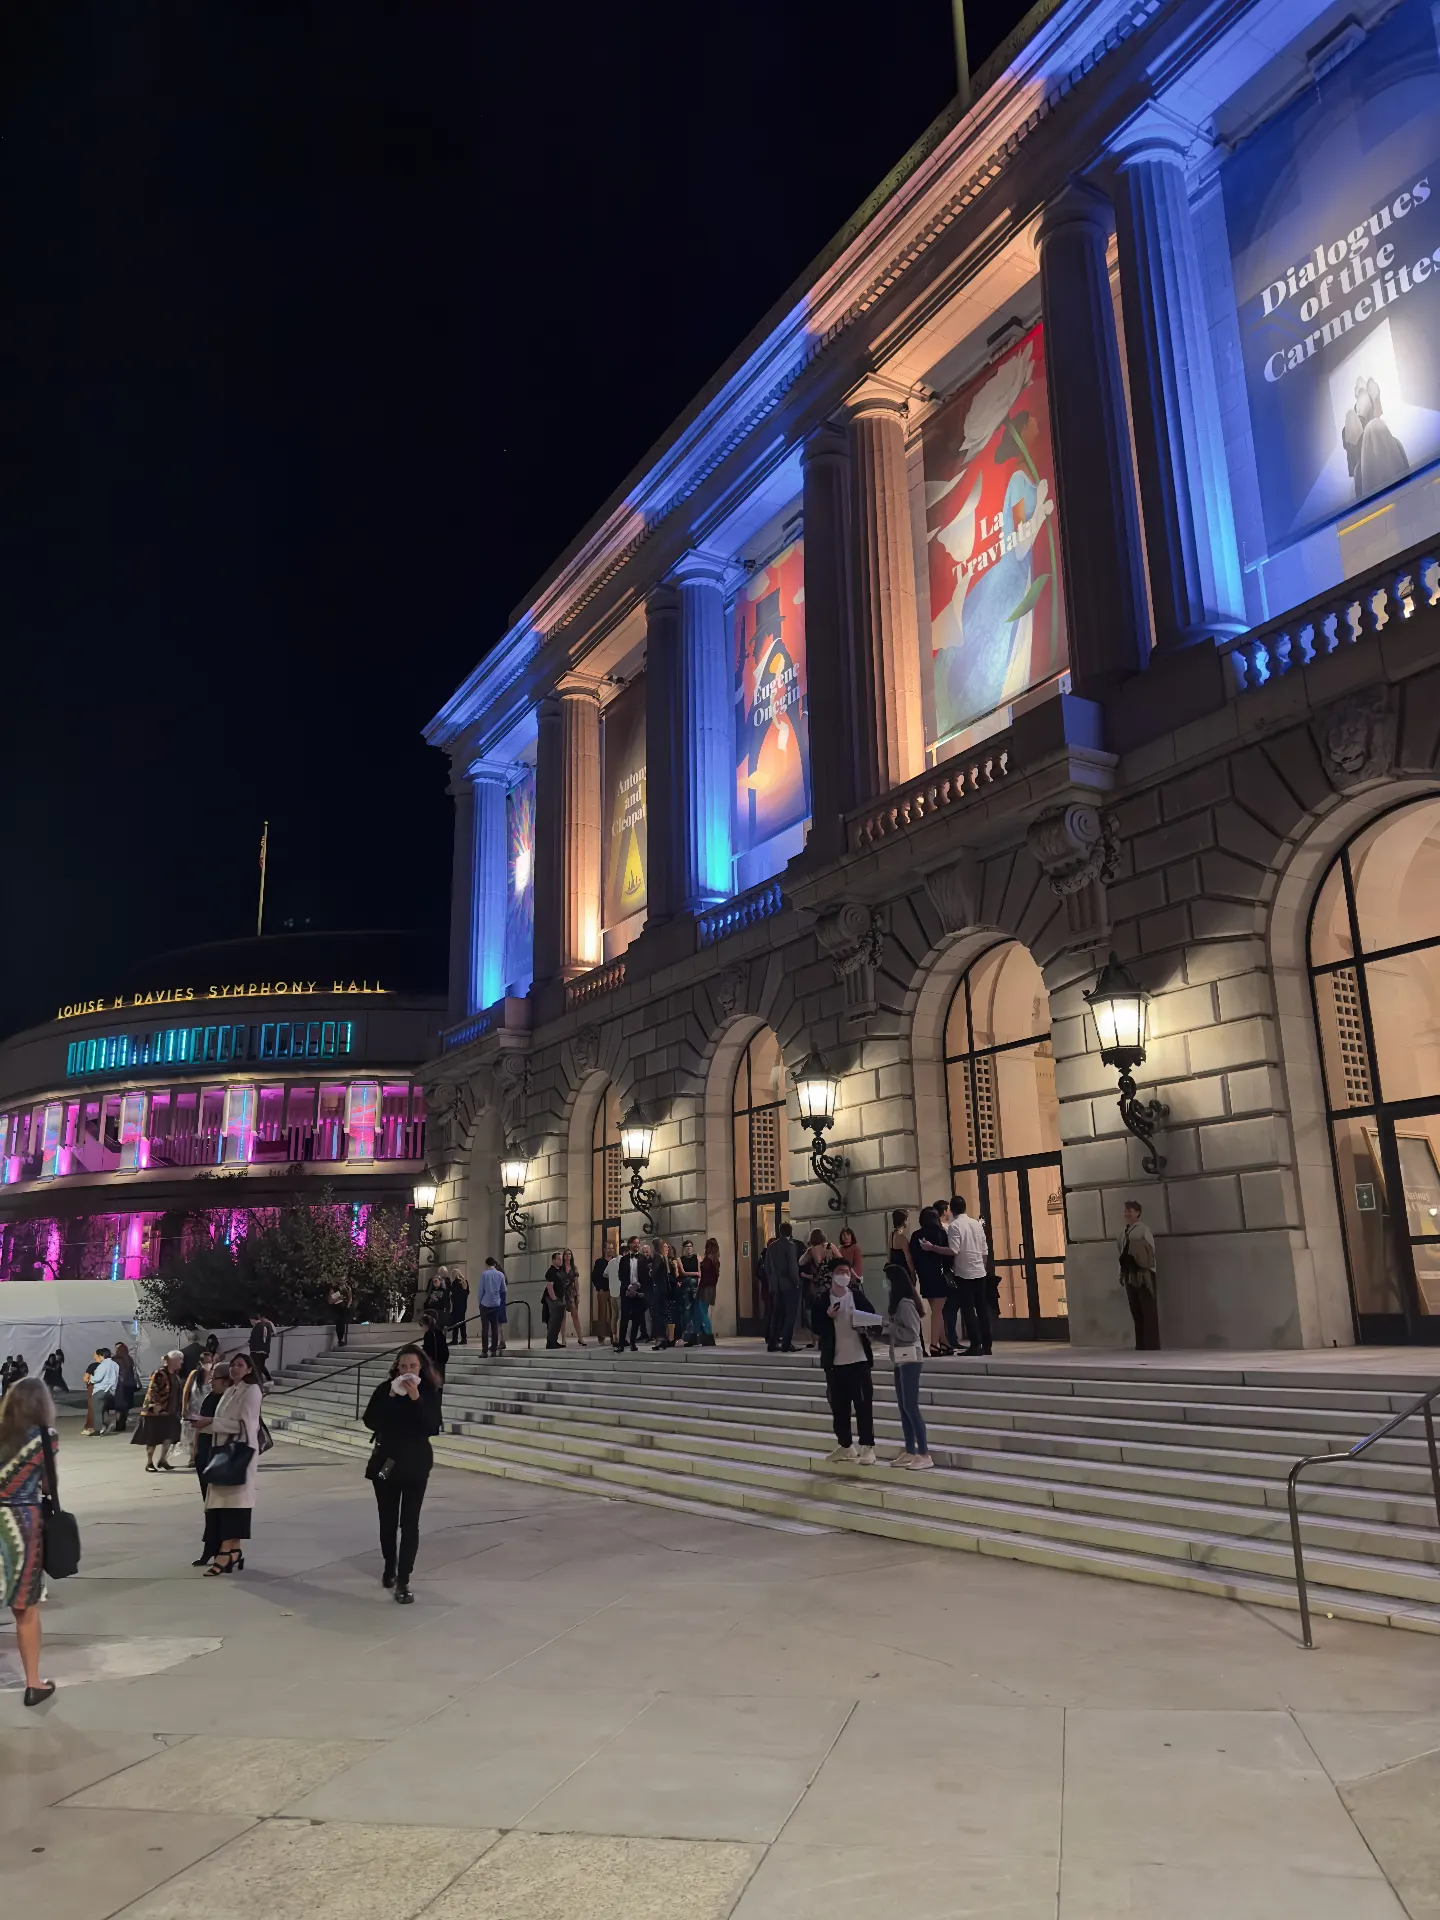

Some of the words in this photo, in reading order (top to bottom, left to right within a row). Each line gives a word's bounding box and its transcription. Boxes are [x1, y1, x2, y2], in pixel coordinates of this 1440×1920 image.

[1260, 177, 1431, 318] Dialogues
[1300, 276, 1333, 322] of
[1338, 243, 1395, 295] the
[979, 511, 1005, 541] La
[951, 519, 1038, 584] Traviata
[753, 662, 800, 706] Eugene
[753, 686, 800, 727] Onegin
[624, 784, 642, 810] and
[57, 998, 104, 1020] LOUISE
[134, 986, 195, 1007] DAVIES
[208, 981, 316, 998] SYMPHONY
[333, 979, 385, 994] HALL
